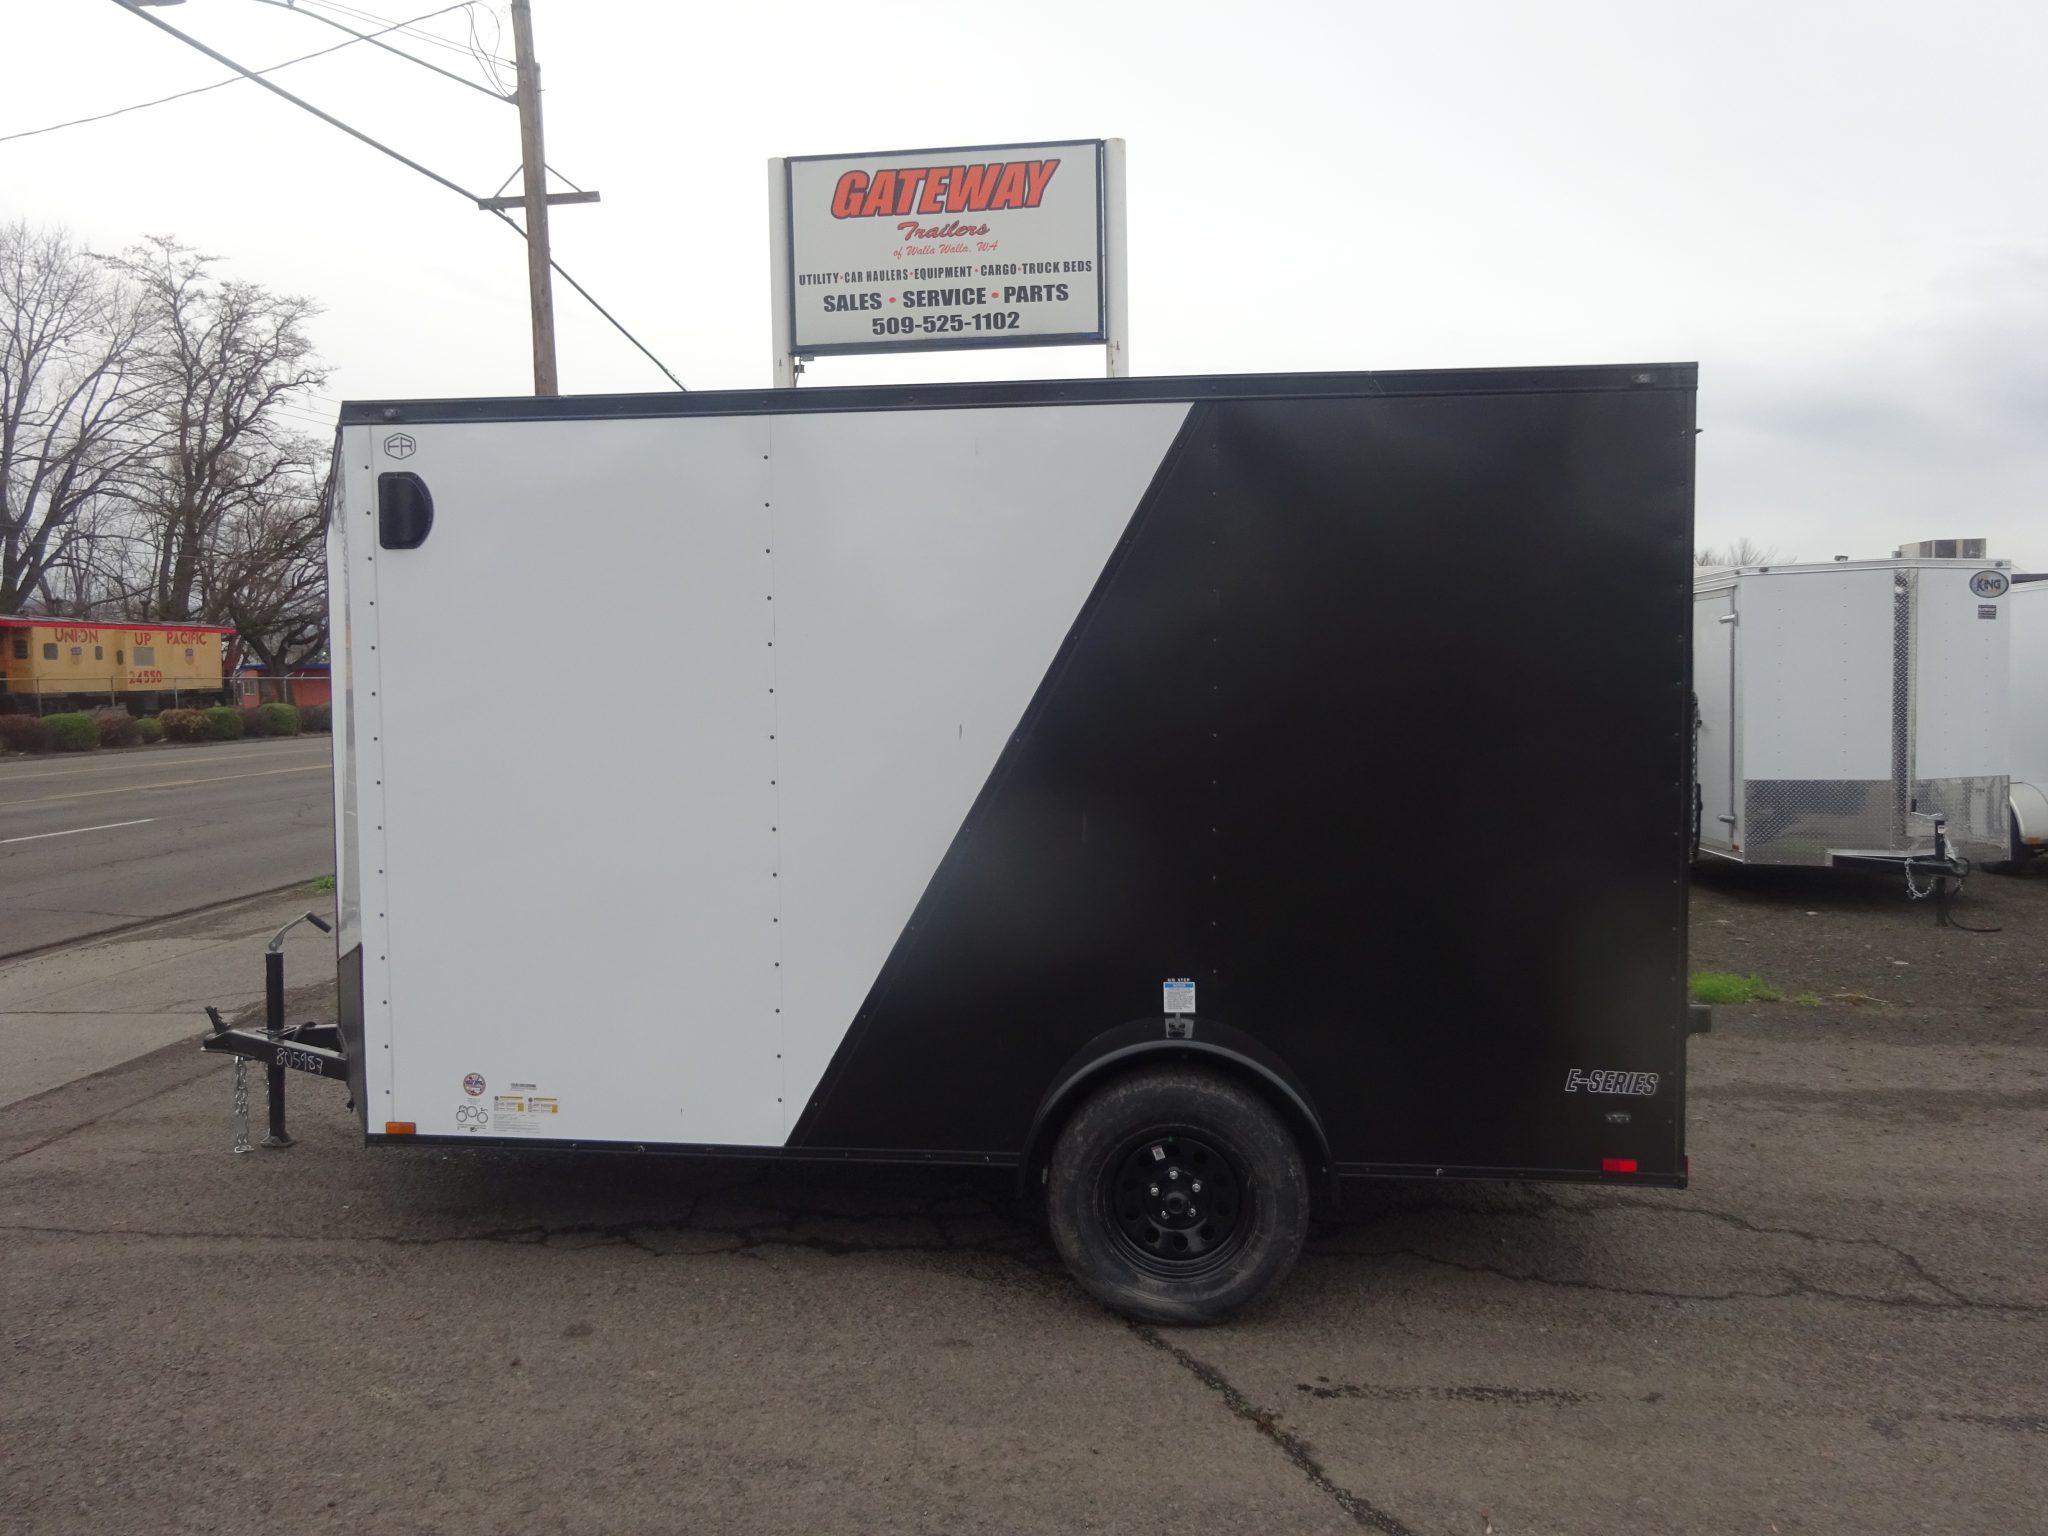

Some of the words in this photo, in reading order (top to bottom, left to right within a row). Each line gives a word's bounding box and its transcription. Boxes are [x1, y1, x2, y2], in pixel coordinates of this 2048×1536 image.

[830, 158, 1061, 220] GATEWAY
[897, 219, 990, 241] Trailers
[893, 247, 903, 260] of
[905, 245, 936, 256] Walla
[976, 240, 999, 252] WA
[799, 273, 840, 286] UTILITY
[844, 271, 864, 284] CAR
[866, 268, 909, 282] HAULERS
[914, 265, 973, 280] EQUIPMENT
[980, 263, 1017, 277] CARGO
[1022, 261, 1061, 275] TRUCK
[1063, 260, 1093, 273] BEDS
[823, 292, 883, 313] SALES
[902, 288, 987, 309] SERVICE
[1003, 283, 1069, 304] PARTS
[872, 311, 1020, 335] 509-525-1102
[54, 628, 99, 643] UNION
[134, 632, 152, 646] UP
[166, 632, 207, 646] PACIFIC
[129, 670, 162, 684] 24550
[1564, 1068, 1659, 1096] E-SERIES
